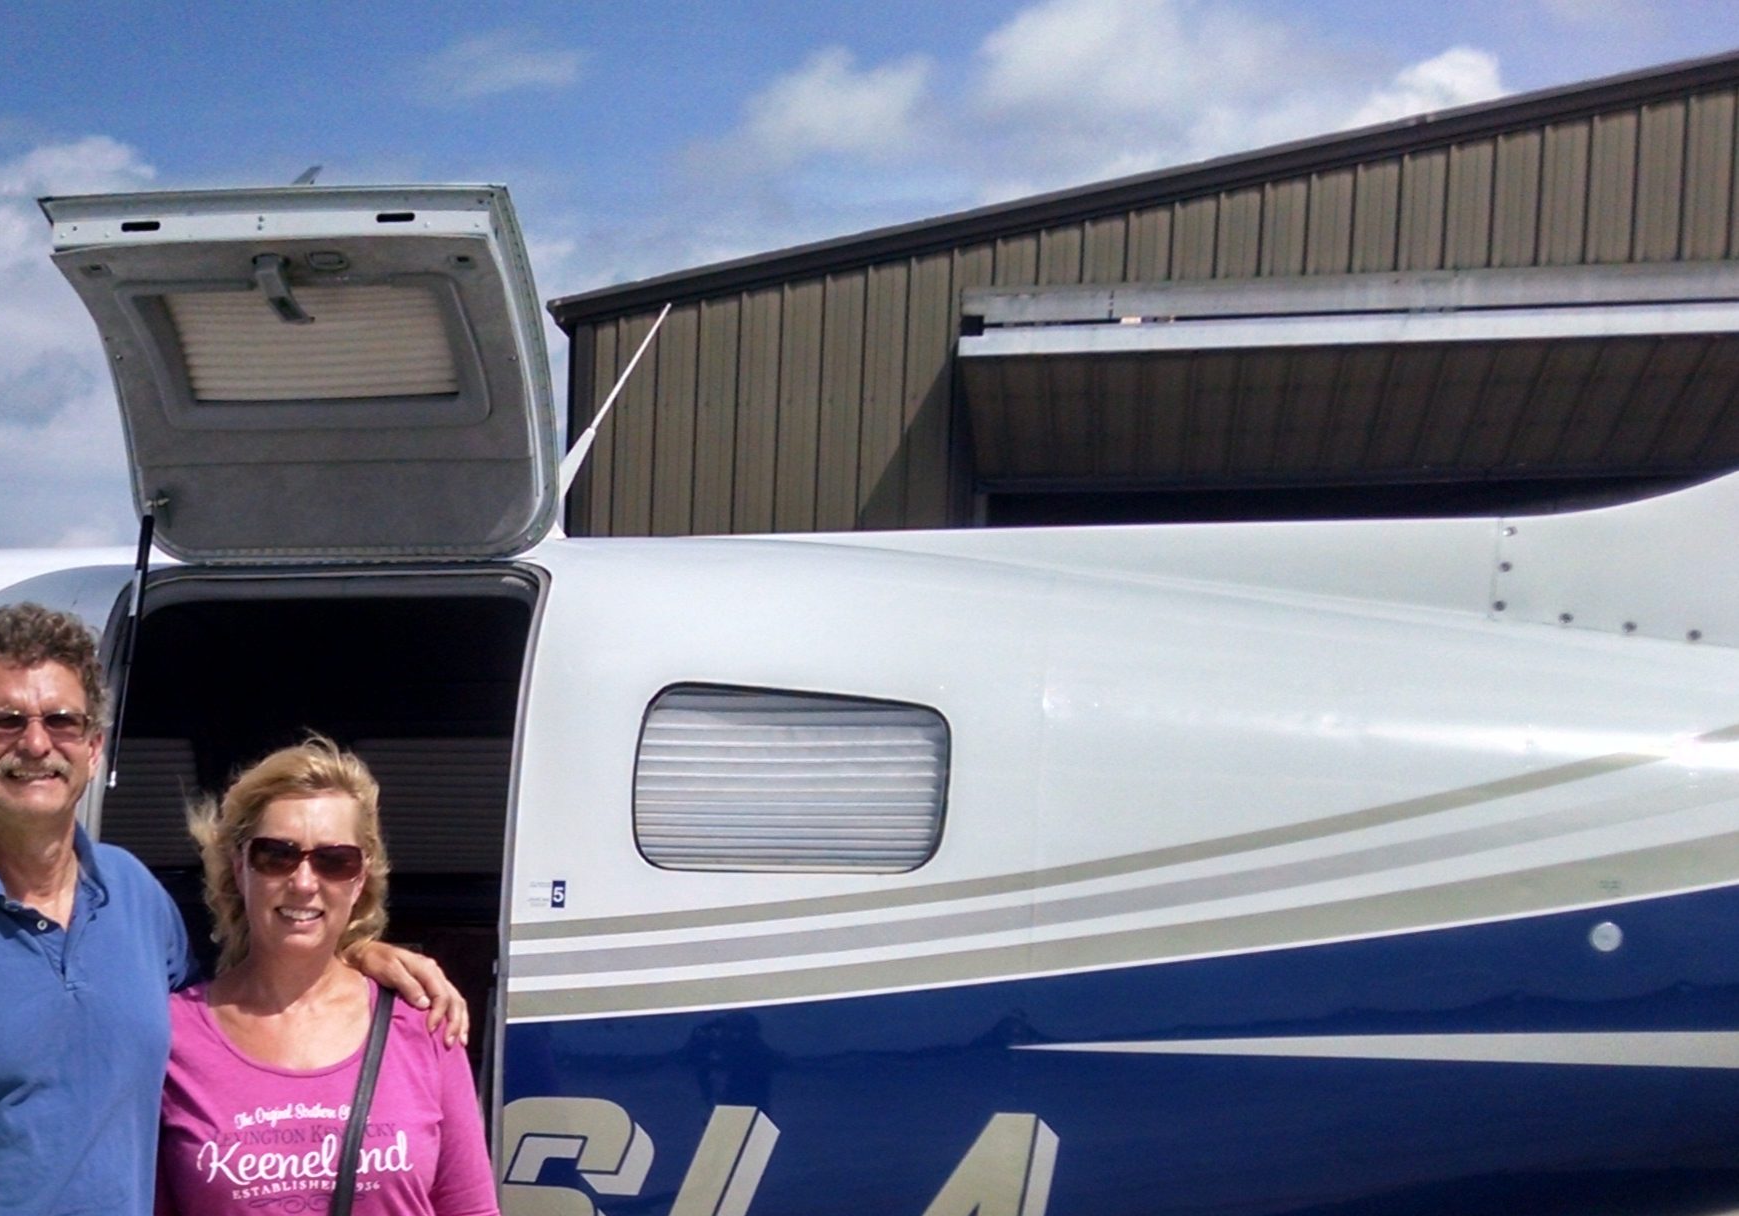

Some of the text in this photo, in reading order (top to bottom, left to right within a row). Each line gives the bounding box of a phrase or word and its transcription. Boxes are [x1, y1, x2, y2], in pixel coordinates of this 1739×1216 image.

[553, 886, 564, 902] 5
[234, 1112, 256, 1130] The
[255, 1103, 293, 1128] Original
[295, 1103, 336, 1119] Southern
[196, 1130, 414, 1185] Keenelnd
